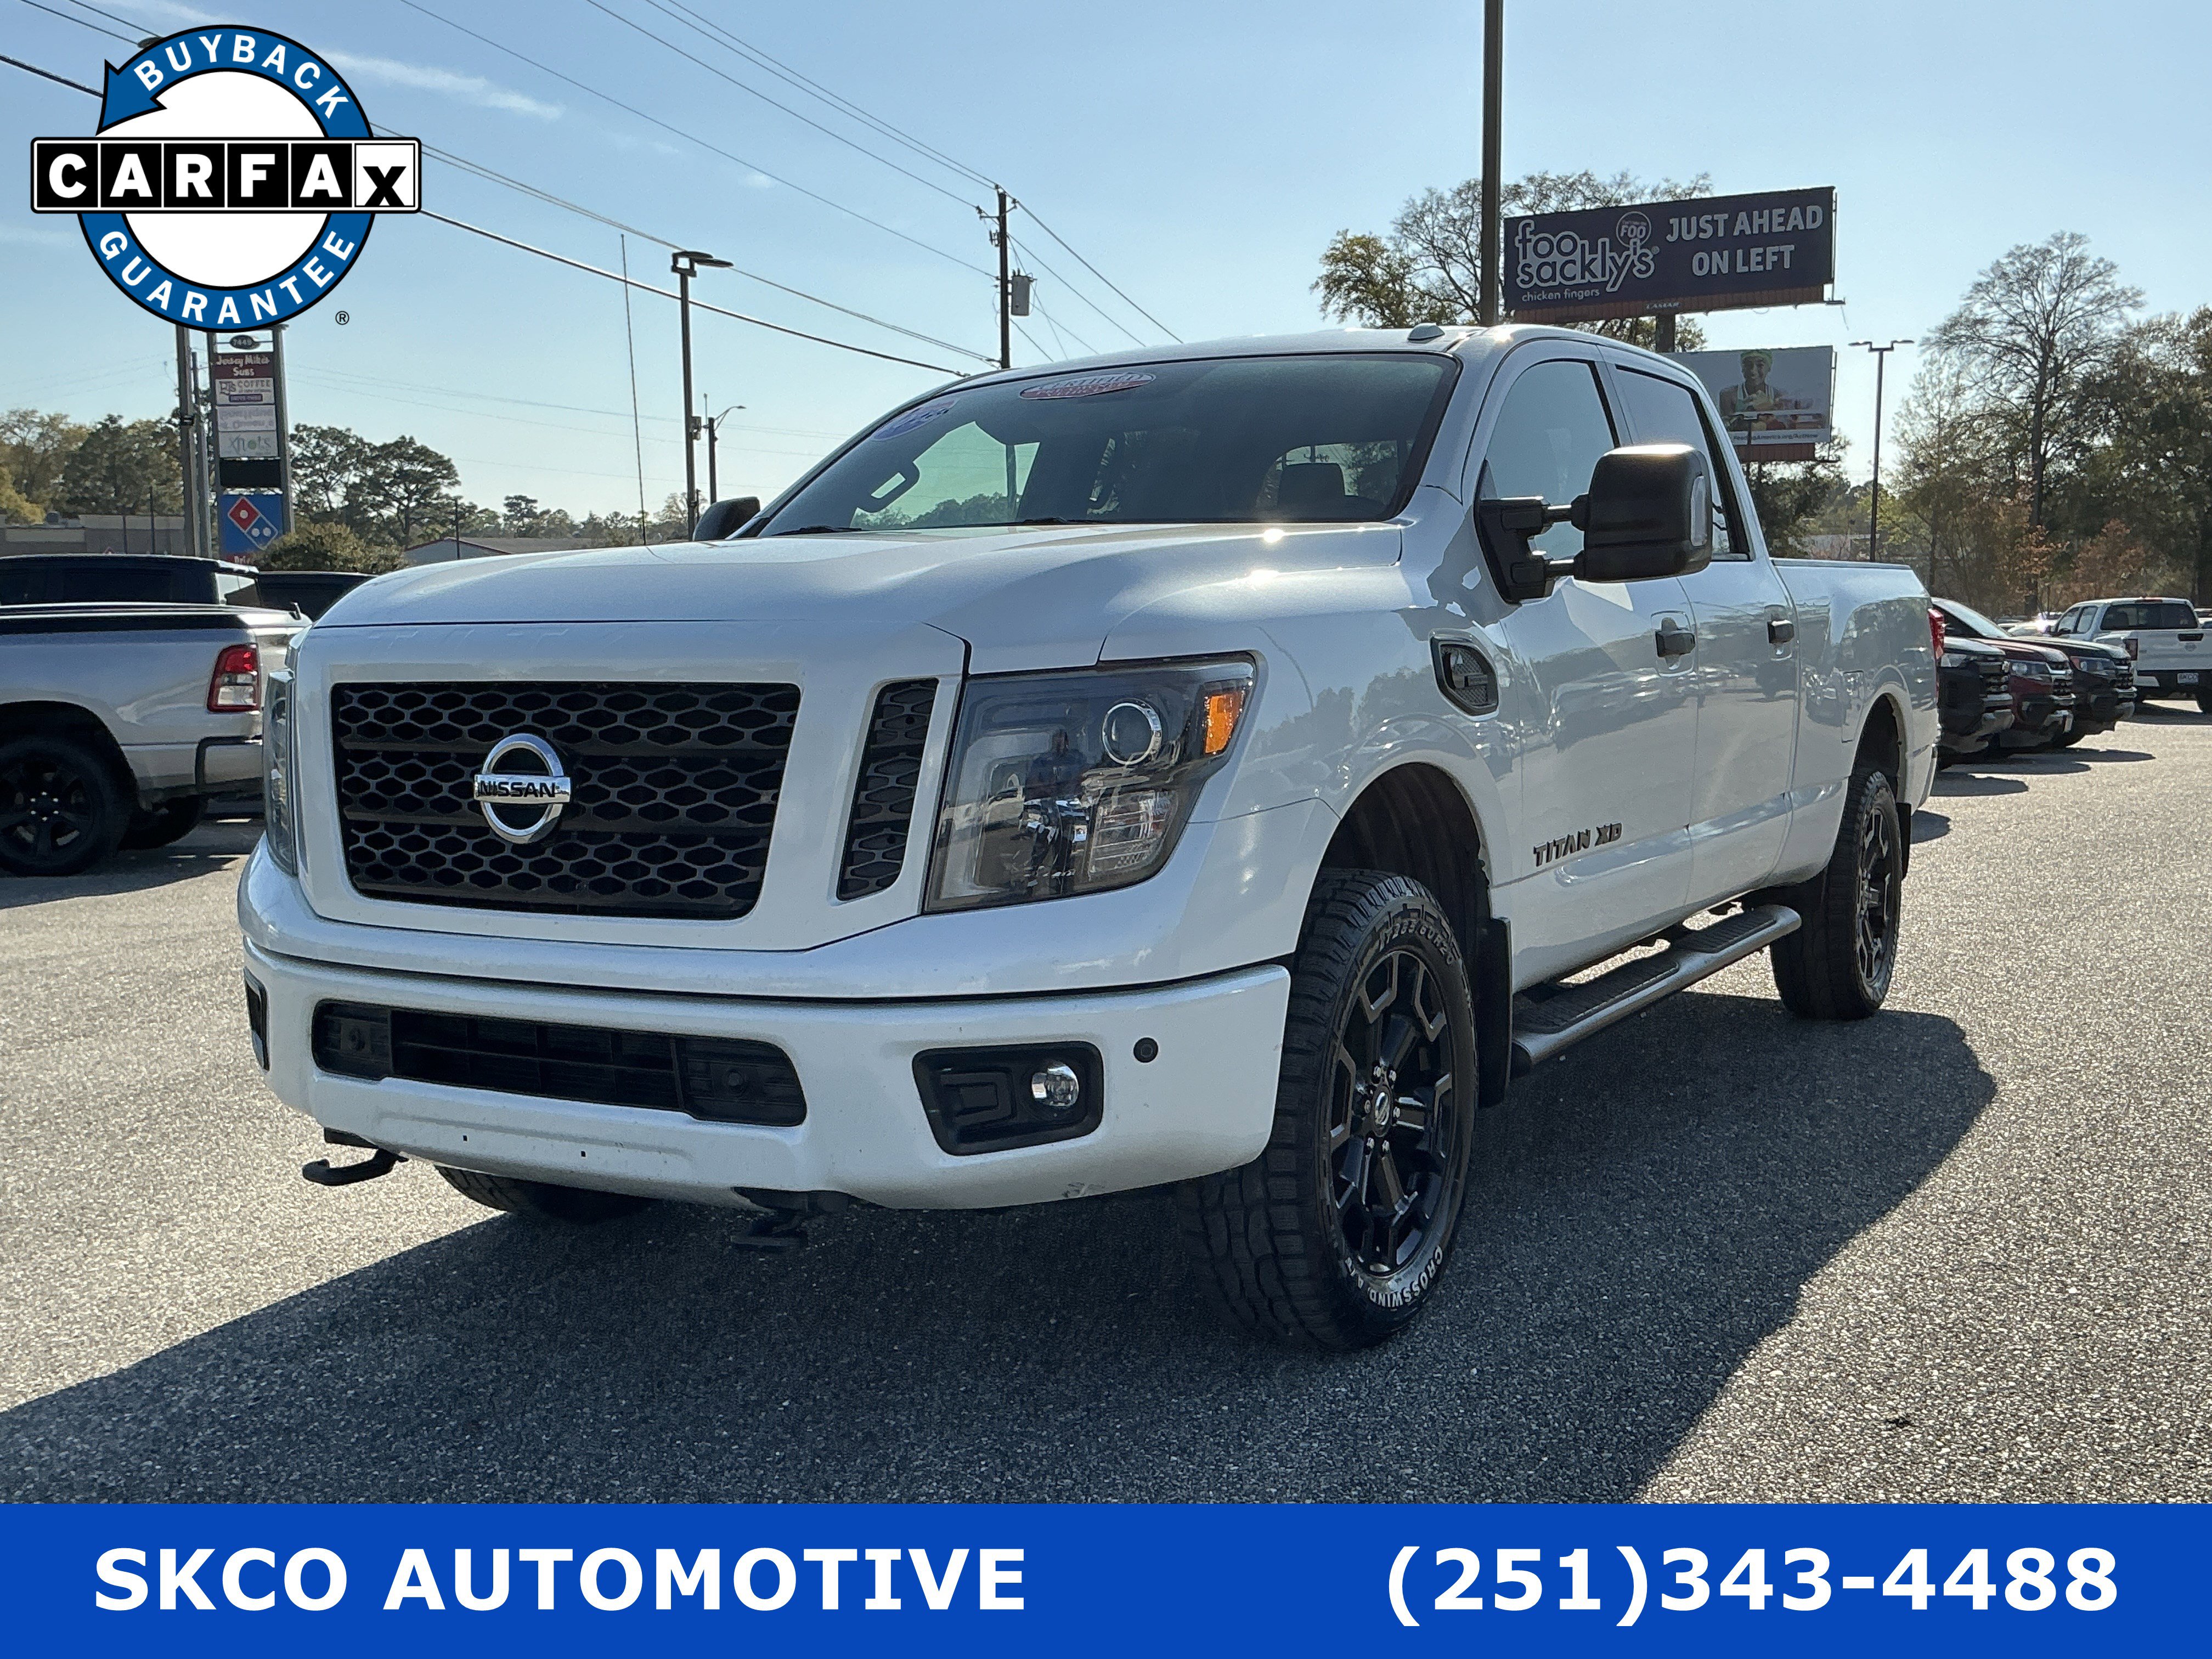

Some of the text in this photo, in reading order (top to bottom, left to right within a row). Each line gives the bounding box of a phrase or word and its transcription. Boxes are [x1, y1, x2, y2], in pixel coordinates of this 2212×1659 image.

[1515, 219, 1581, 261] foo
[1620, 224, 1646, 239] FOO
[1666, 205, 1823, 242] JUST AHEAD
[1516, 237, 1655, 292] sackly's
[1692, 245, 1795, 276] ON LEFT
[1521, 288, 1600, 302] chicken fingers
[478, 780, 556, 798] NISSAN
[1533, 822, 1622, 867] TITAN XD
[1369, 1245, 1443, 1308] CROSSWIND
